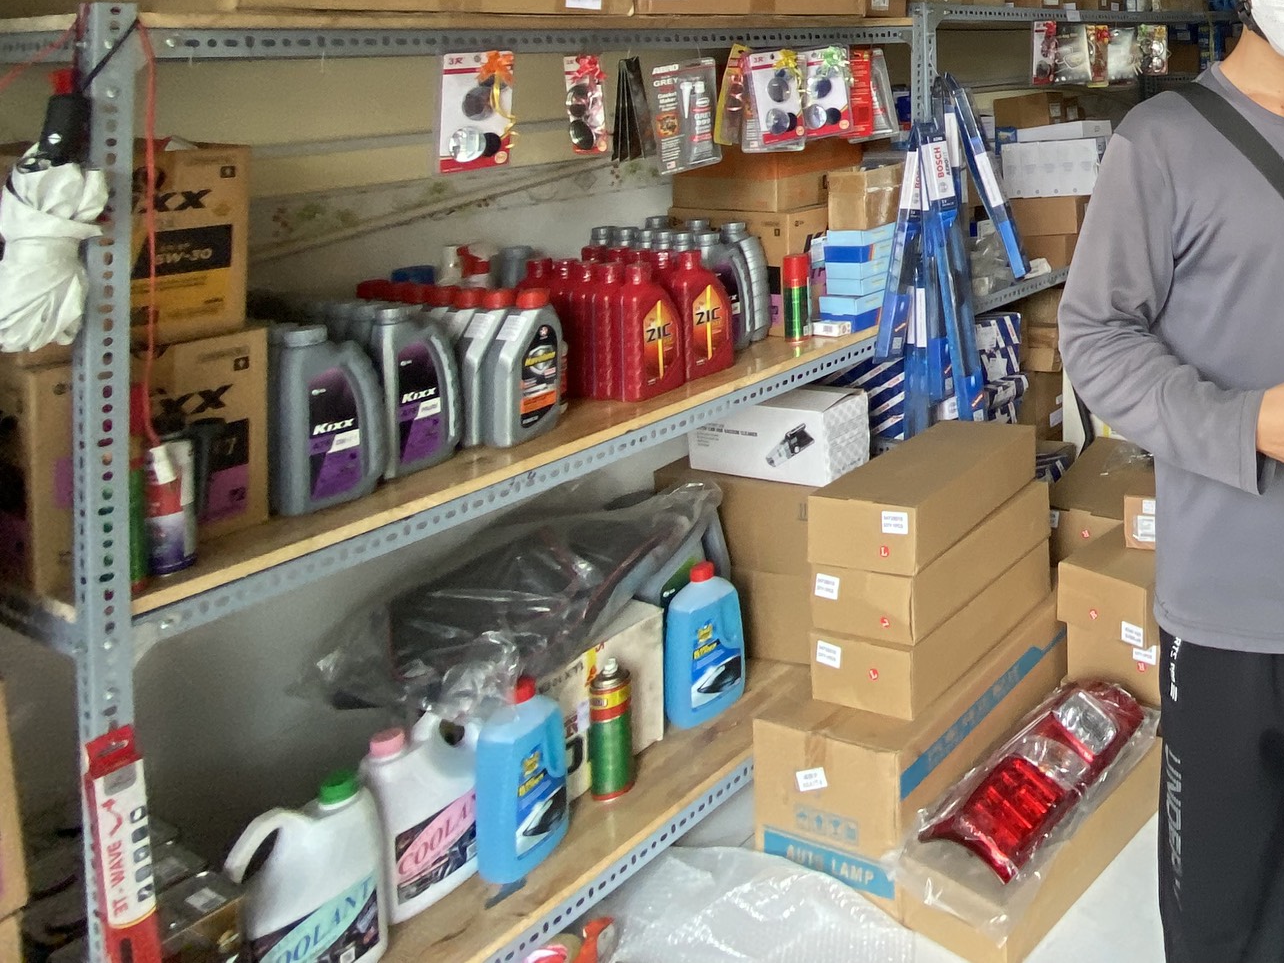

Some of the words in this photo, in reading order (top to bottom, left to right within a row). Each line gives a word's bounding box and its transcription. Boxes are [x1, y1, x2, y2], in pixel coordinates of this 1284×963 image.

[653, 77, 679, 87] GREY
[934, 147, 945, 179] BOSCH
[695, 306, 721, 326] ZIC
[646, 322, 671, 343] ZIC
[402, 387, 438, 404] Kixx
[313, 418, 355, 436] Kixx
[786, 844, 824, 871] AUTO
[831, 858, 875, 886] LAMP
[275, 875, 372, 963] OOLANT
